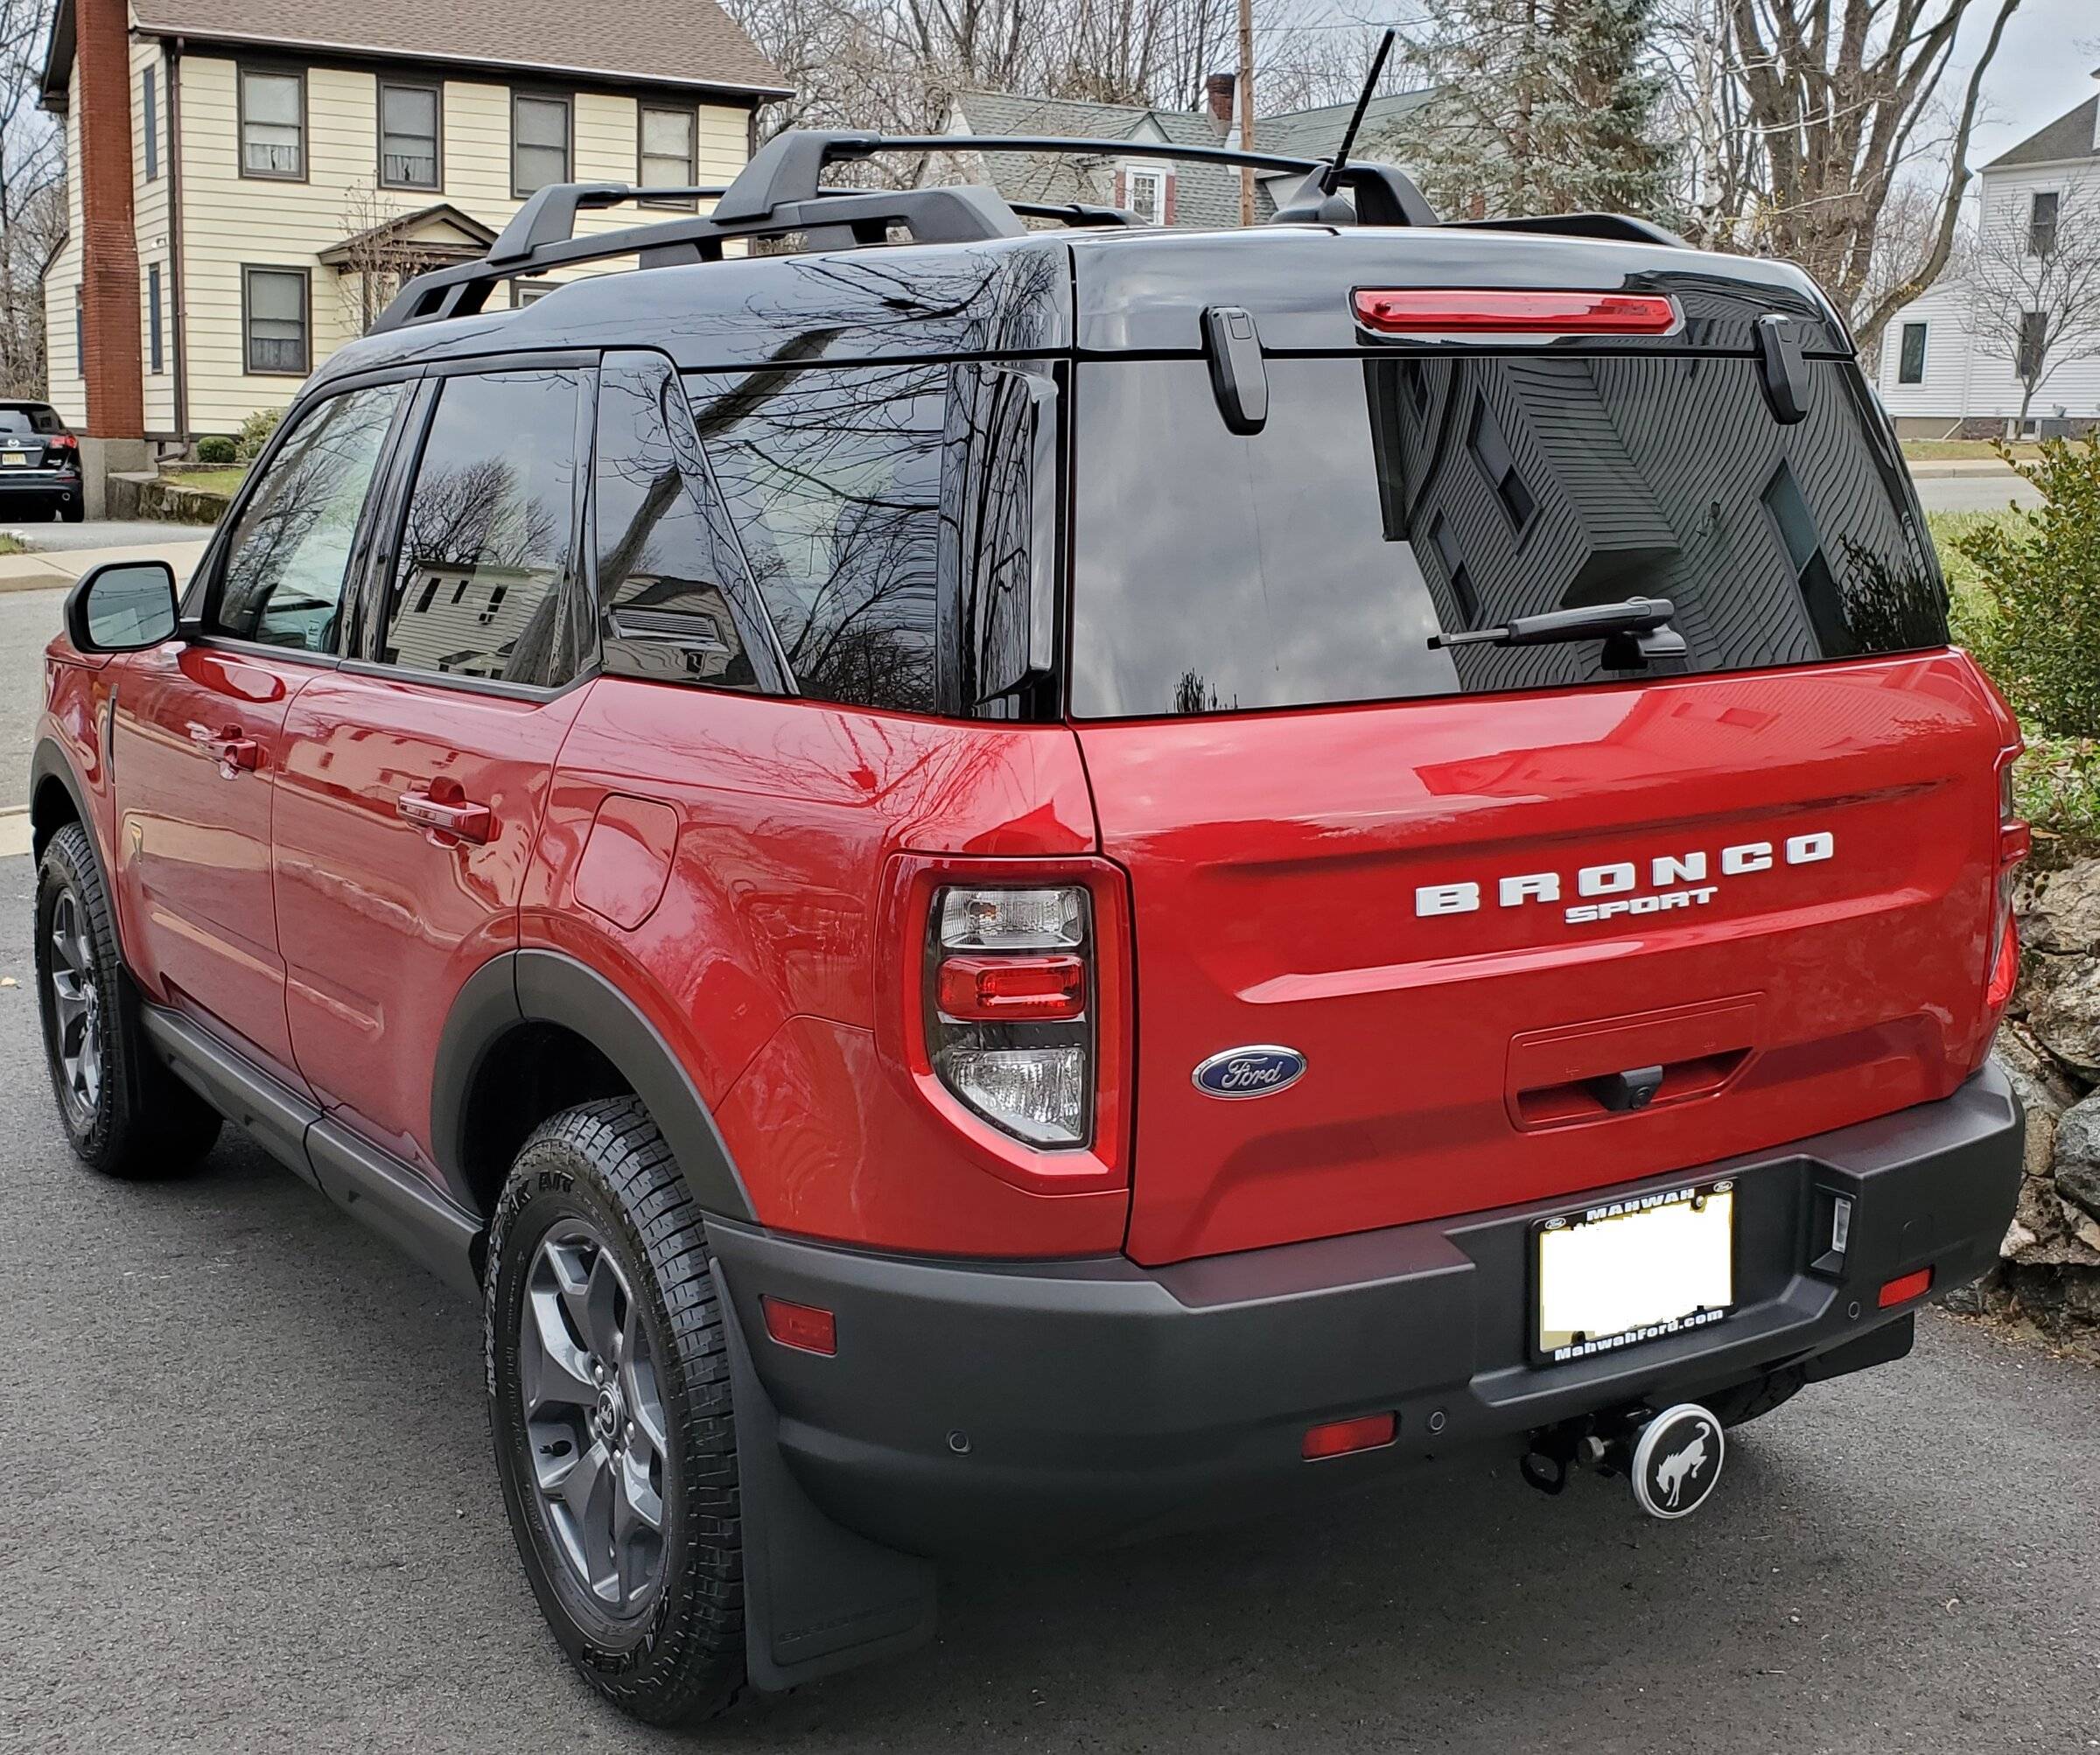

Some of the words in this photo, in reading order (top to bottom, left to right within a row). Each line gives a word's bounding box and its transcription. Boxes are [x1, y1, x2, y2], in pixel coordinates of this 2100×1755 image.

[1415, 831, 1834, 918] BRONCO
[1564, 886, 1718, 924] SPORT
[1221, 1057, 1284, 1088] Ford
[1586, 1188, 1696, 1221] MAHWAH
[1554, 1309, 1724, 1361] MahwahFord.com
